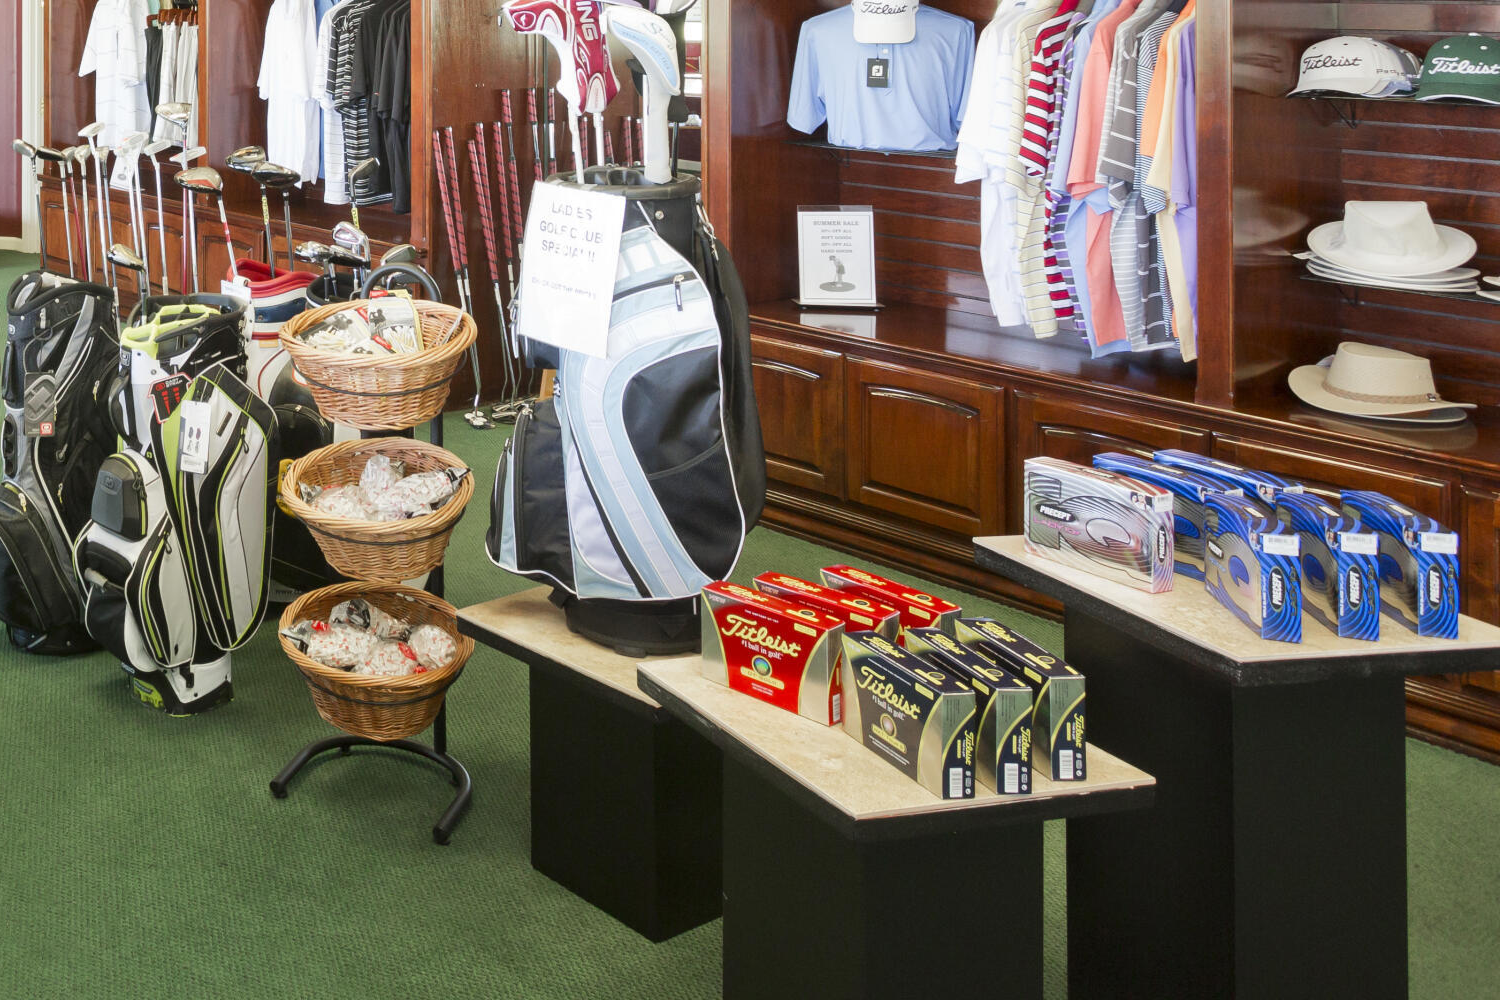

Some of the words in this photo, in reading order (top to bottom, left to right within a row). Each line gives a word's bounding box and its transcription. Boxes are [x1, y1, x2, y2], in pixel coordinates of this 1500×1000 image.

[861, 1, 908, 15] Titleist
[1302, 54, 1363, 74] Titleist
[1428, 56, 1500, 75] Titleist
[552, 200, 593, 221] LADES
[569, 227, 603, 243] CUB
[1039, 505, 1072, 522] PRECEPT
[1270, 572, 1282, 606] PRECEPT
[1349, 571, 1360, 604] PRECEPT
[1429, 570, 1440, 604] PRECEPT
[721, 613, 802, 657] Titleist
[748, 641, 760, 653] ball
[760, 646, 767, 655] in
[856, 665, 921, 720] Titleist
